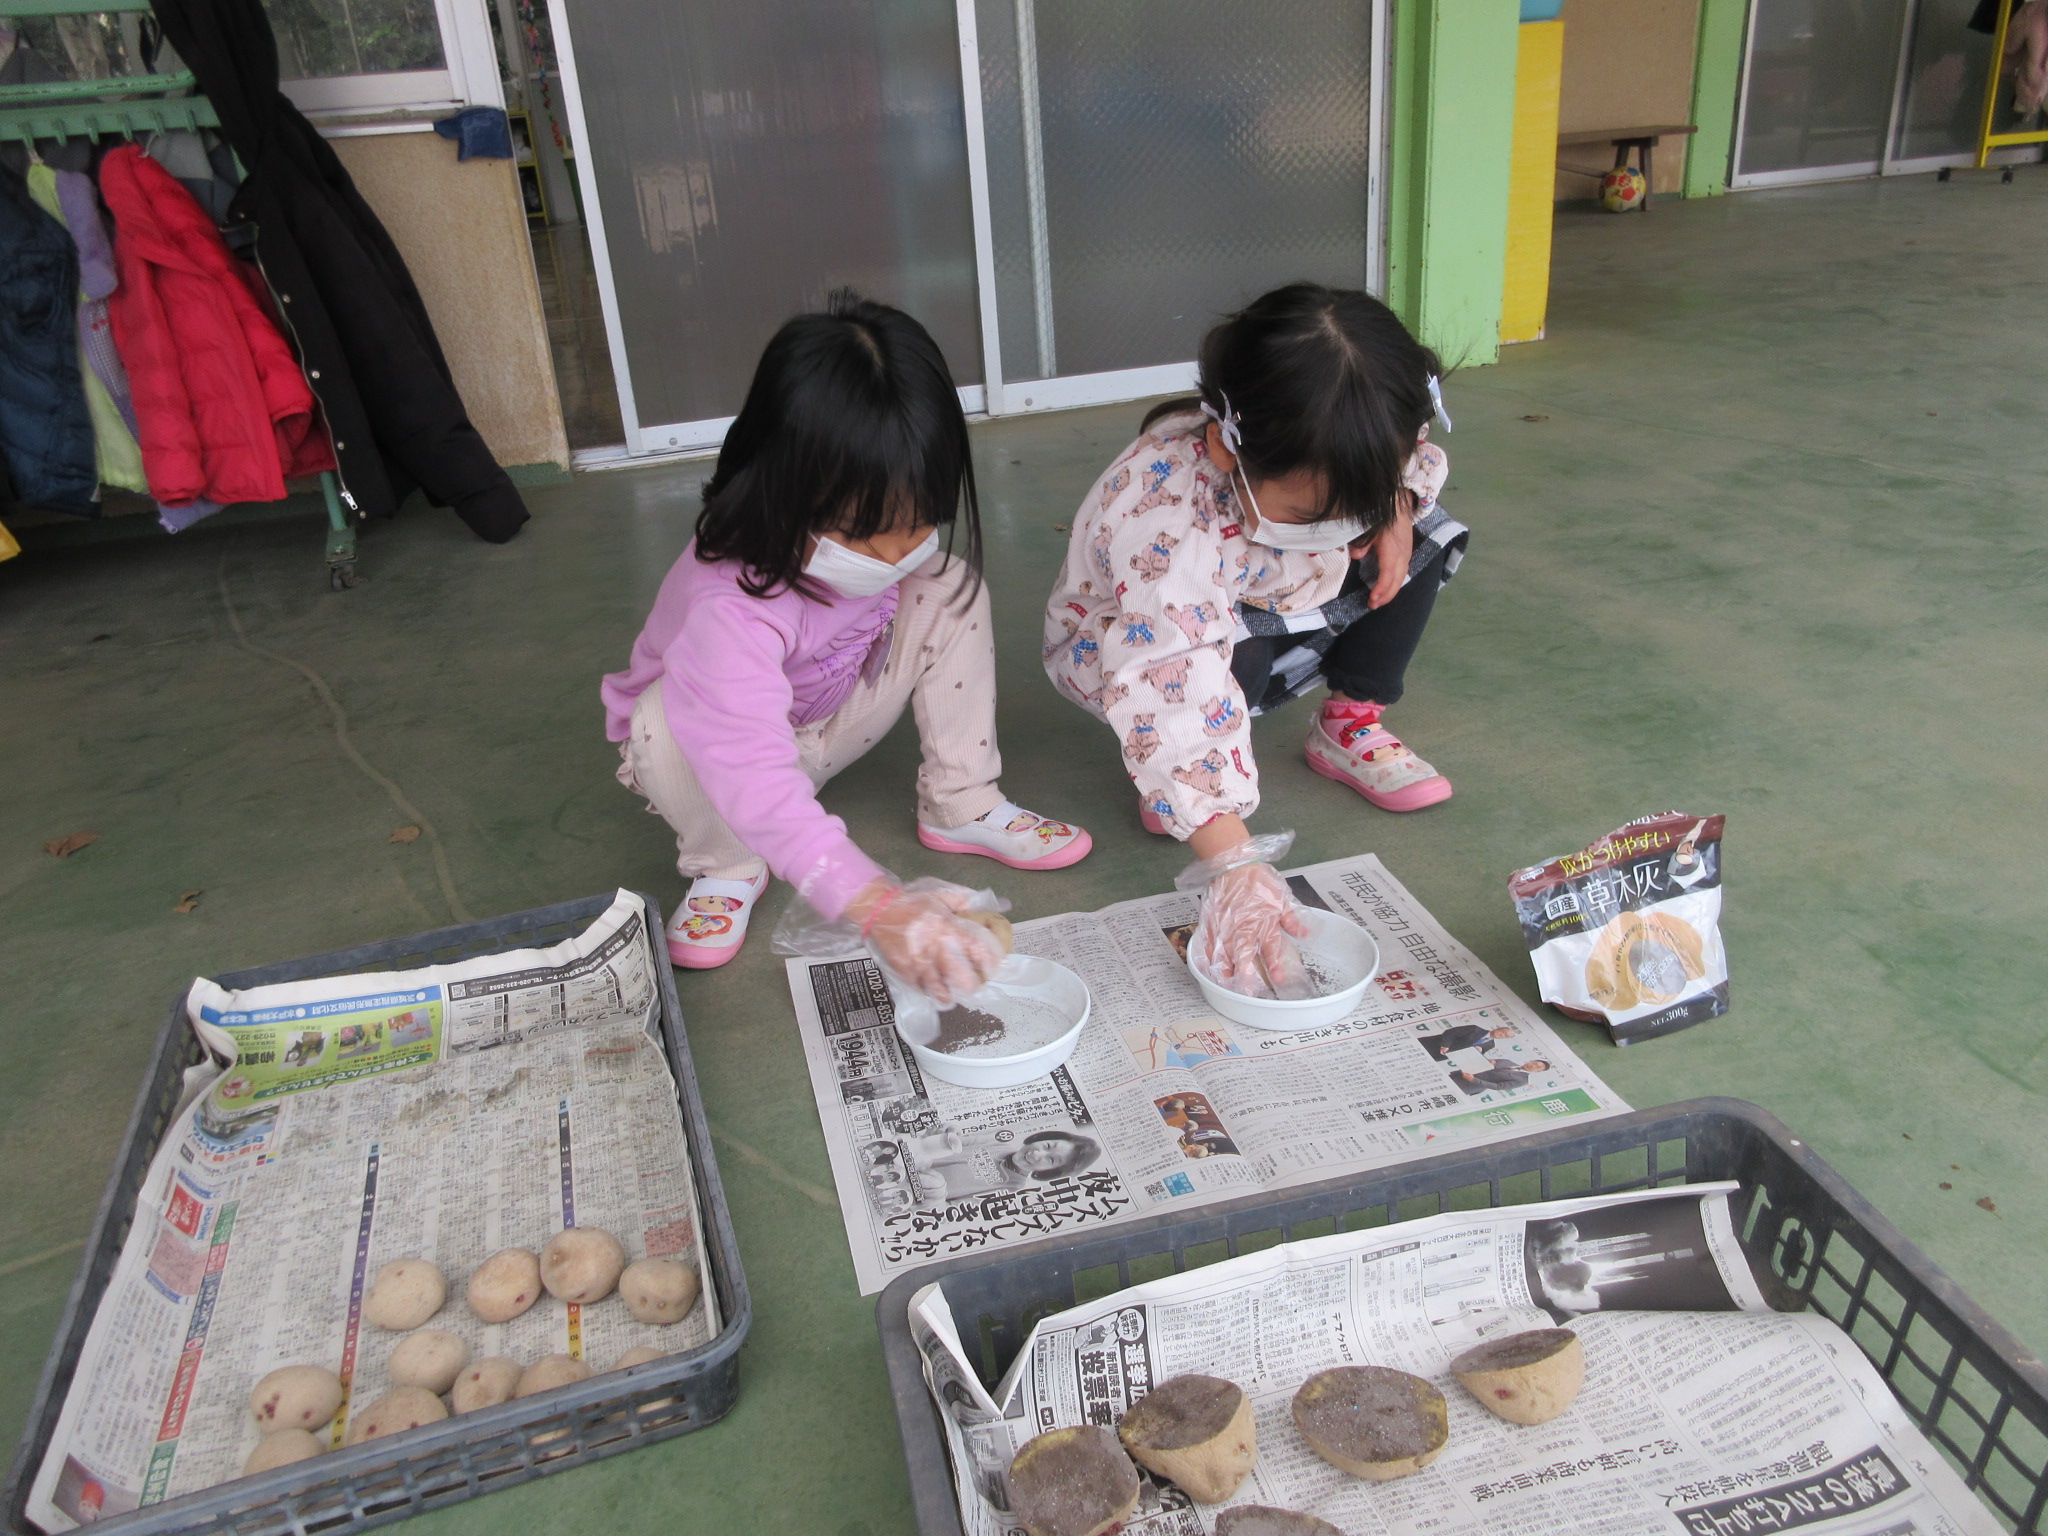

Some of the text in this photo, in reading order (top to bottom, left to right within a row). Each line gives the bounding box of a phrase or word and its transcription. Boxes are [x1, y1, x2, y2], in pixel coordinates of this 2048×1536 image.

[1560, 832, 1670, 877] 灰がつけやすい
[1582, 860, 1663, 913] 草木灰
[1549, 897, 1576, 916] 国産
[1335, 871, 1484, 1003] 市民が協力 自由な撮影
[310, 991, 415, 1016] 茨城県指定無形民俗文化財
[862, 968, 897, 1024] 0120-37-8353
[1372, 975, 1404, 1001] めぐり
[524, 1005, 635, 1036] オープンカレッジ
[1253, 1001, 1445, 1051] 地元食材の炊き出しも
[1358, 1091, 1461, 1125] 鹿嶋市、DX推進
[1481, 1095, 1571, 1129] 鹿行
[885, 1192, 1131, 1263] ムズムズしないから
[1118, 1314, 1131, 1336] 訴求力
[1126, 1310, 1141, 1338] 圧倒的な
[1076, 1349, 1115, 1428] 投票率
[1041, 1408, 1052, 1424] 水戸
[1468, 1436, 1685, 1505] 高い信頼も商業面苦戦
[1664, 1439, 1834, 1508] 観測衛星を軌道投入
